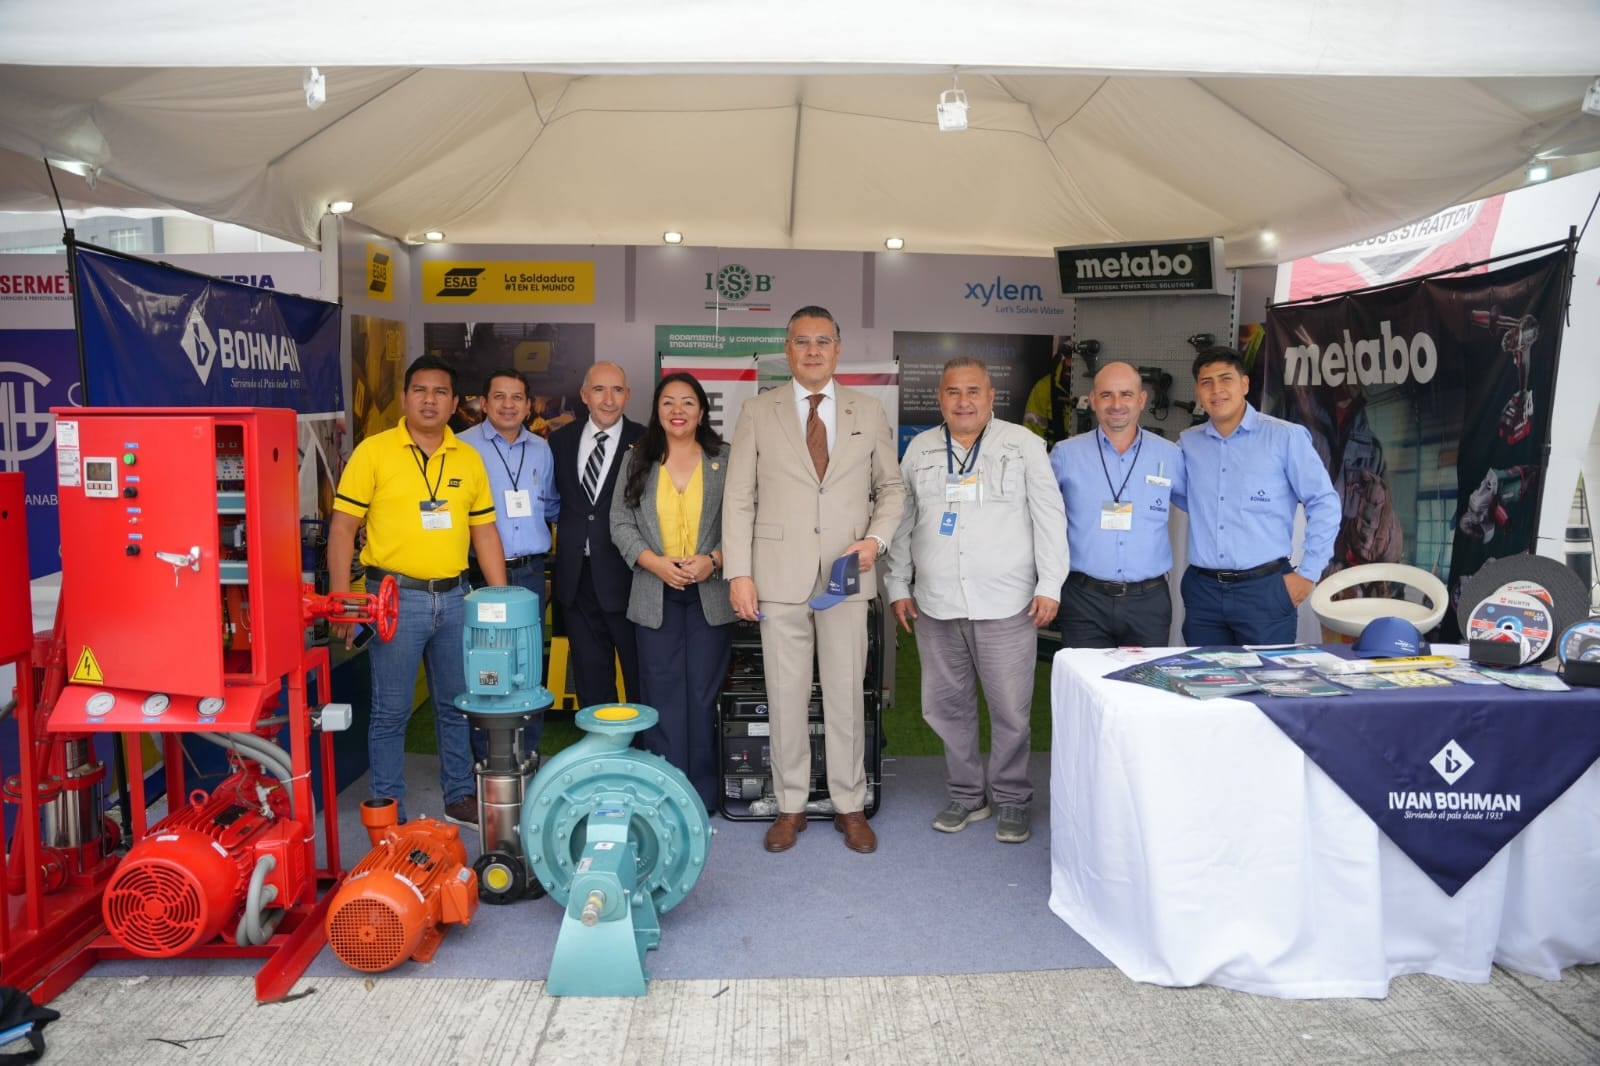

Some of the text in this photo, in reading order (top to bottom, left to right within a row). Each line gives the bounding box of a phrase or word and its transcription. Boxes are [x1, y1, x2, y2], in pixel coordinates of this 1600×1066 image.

[1075, 249, 1193, 279] metabo
[444, 276, 478, 288] ESAB
[504, 273, 575, 283] La Soldadura
[518, 284, 529, 292] EN
[531, 284, 540, 292] EL
[542, 284, 575, 292] MUNDO
[964, 275, 1043, 307] xylem
[1159, 281, 1195, 289] SOLUTIONS
[1016, 305, 1039, 314] Solve
[1040, 306, 1065, 315] Water
[218, 328, 301, 374] BOHMAN
[1283, 320, 1438, 388] metabo
[1388, 791, 1521, 812] IVAN BOHMAN
[1404, 810, 1437, 820] Sirviendo
[1438, 811, 1446, 819] al
[1463, 811, 1483, 820] desde
[1485, 811, 1503, 820] 1935
